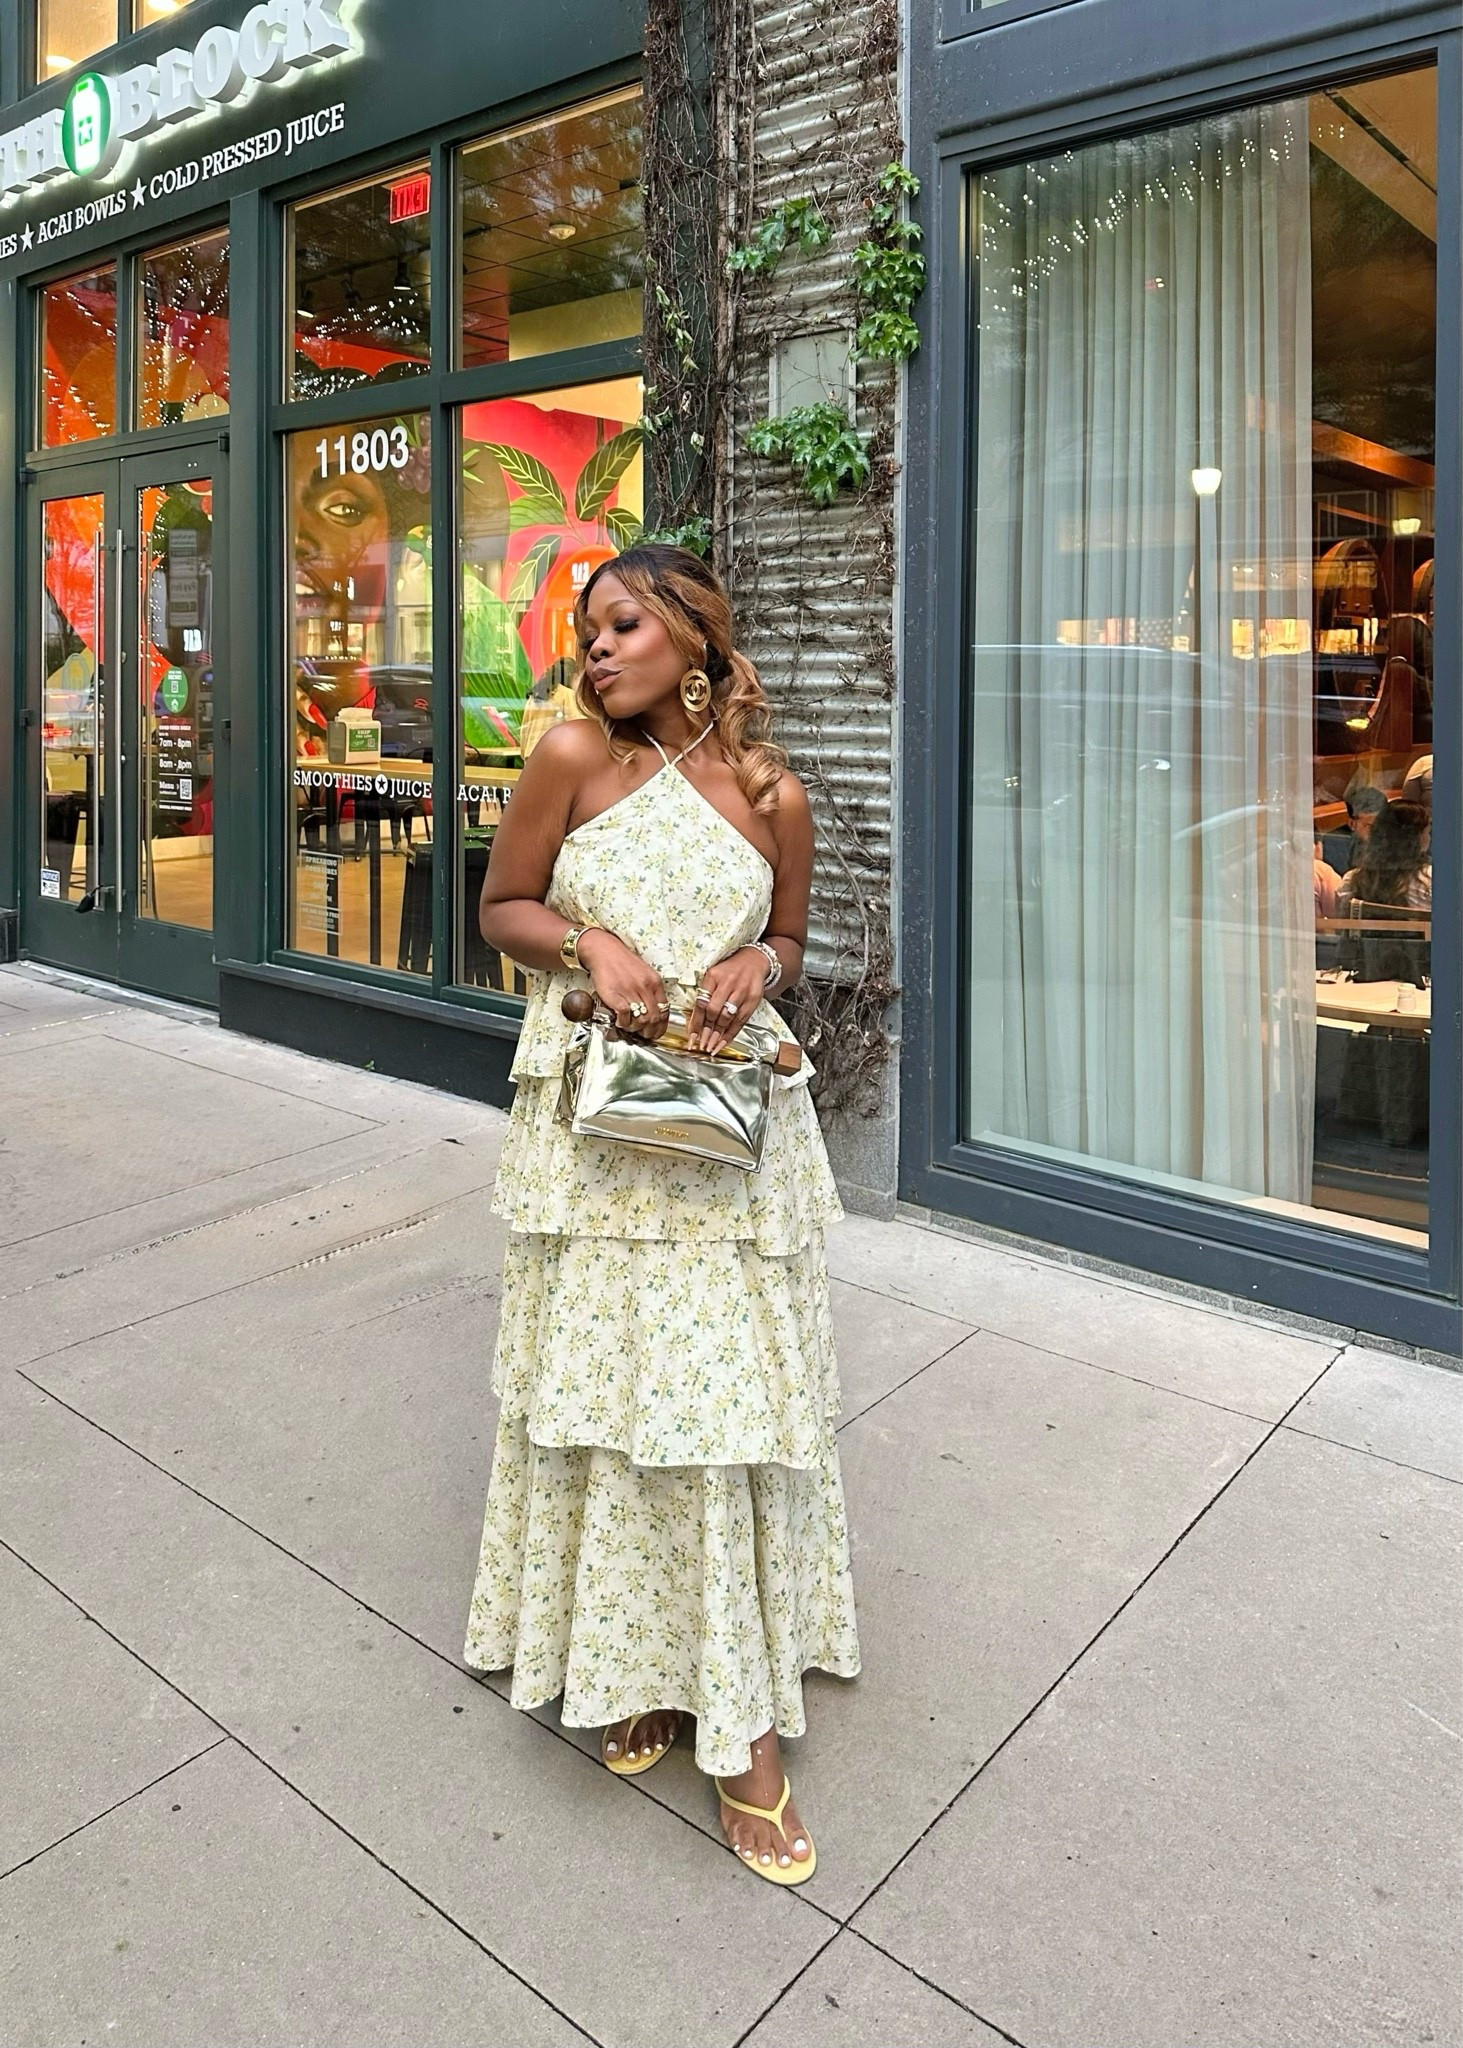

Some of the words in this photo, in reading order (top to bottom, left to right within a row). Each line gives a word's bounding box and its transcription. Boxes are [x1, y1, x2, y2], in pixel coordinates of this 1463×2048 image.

[117, 0, 350, 140] BLOCK
[37, 211, 73, 244] ACAI
[75, 189, 127, 230] BOWLS
[150, 161, 199, 199] COLD
[202, 128, 282, 181] PRESSED
[285, 102, 345, 156] JUICE
[316, 425, 409, 478] 11803
[159, 737, 173, 747] 7am
[293, 770, 373, 792] SMOOTHIES
[389, 778, 432, 798] JUICE
[457, 784, 498, 803] ACAI
